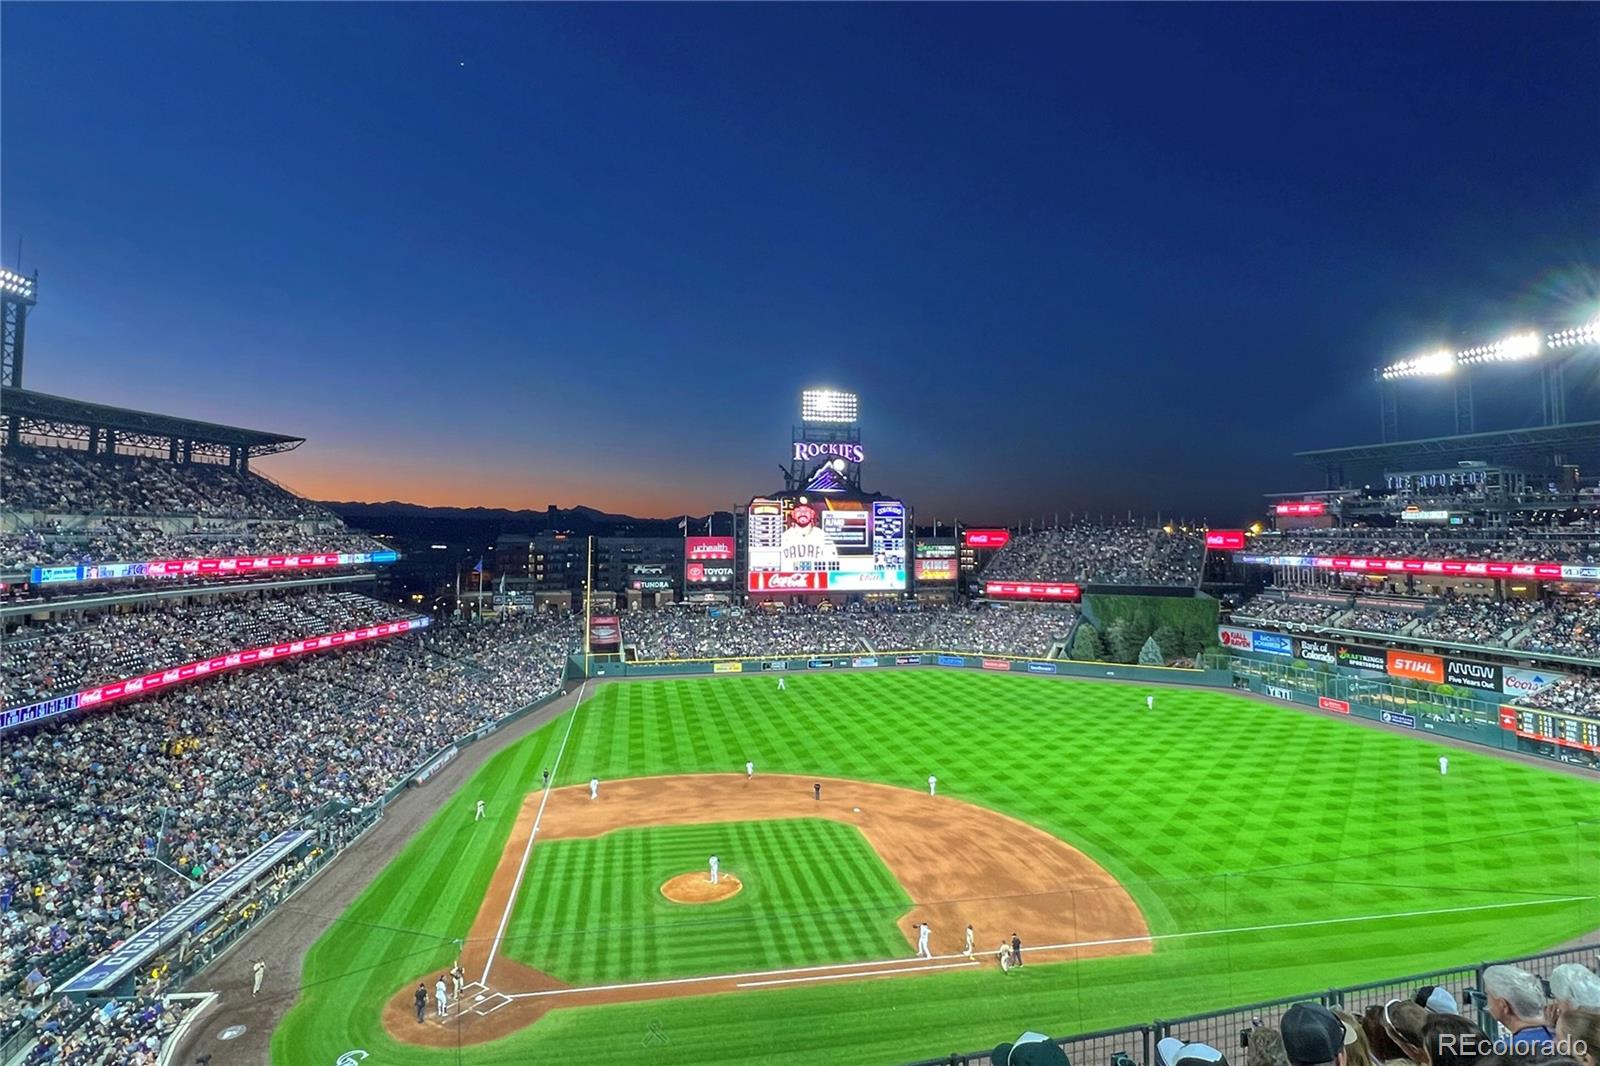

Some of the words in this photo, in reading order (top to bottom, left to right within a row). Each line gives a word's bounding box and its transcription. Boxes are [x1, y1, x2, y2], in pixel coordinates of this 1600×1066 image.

[794, 443, 864, 462] ROCKIES
[1388, 475, 1411, 489] THE
[1420, 471, 1486, 488] ROOFTOP
[694, 543, 728, 553] uchealth
[1301, 640, 1321, 651] Bank
[1323, 643, 1329, 653] of
[1301, 649, 1336, 663] Colorado
[1394, 659, 1435, 675] STIHL
[1448, 676, 1463, 685] Five
[1462, 677, 1481, 688] Years
[1481, 680, 1495, 690] Out
[1267, 685, 1292, 700] YETI
[103, 931, 165, 966] FIELD
